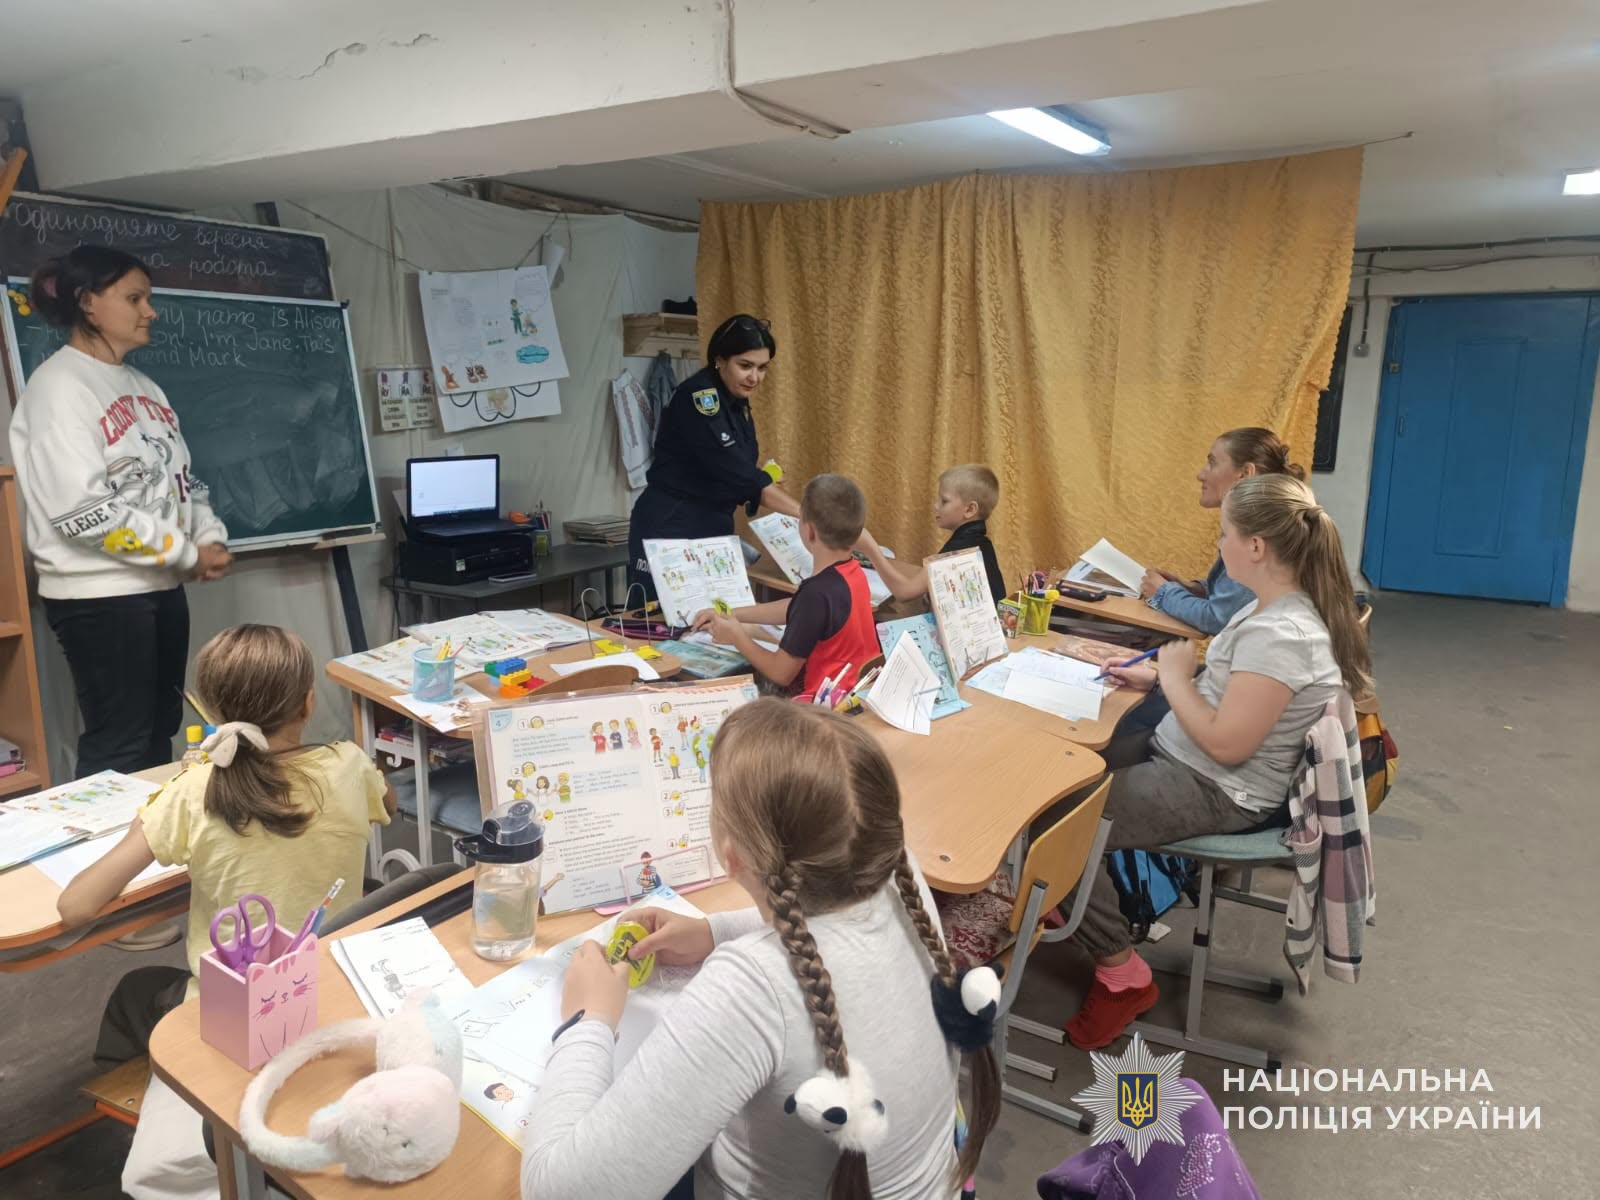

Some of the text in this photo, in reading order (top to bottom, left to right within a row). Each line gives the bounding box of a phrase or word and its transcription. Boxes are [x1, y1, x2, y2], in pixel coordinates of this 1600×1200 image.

[194, 228, 269, 253] вересня
[190, 253, 277, 280] робота
[197, 307, 255, 327] name
[271, 306, 289, 328] is
[189, 348, 248, 368] Mark
